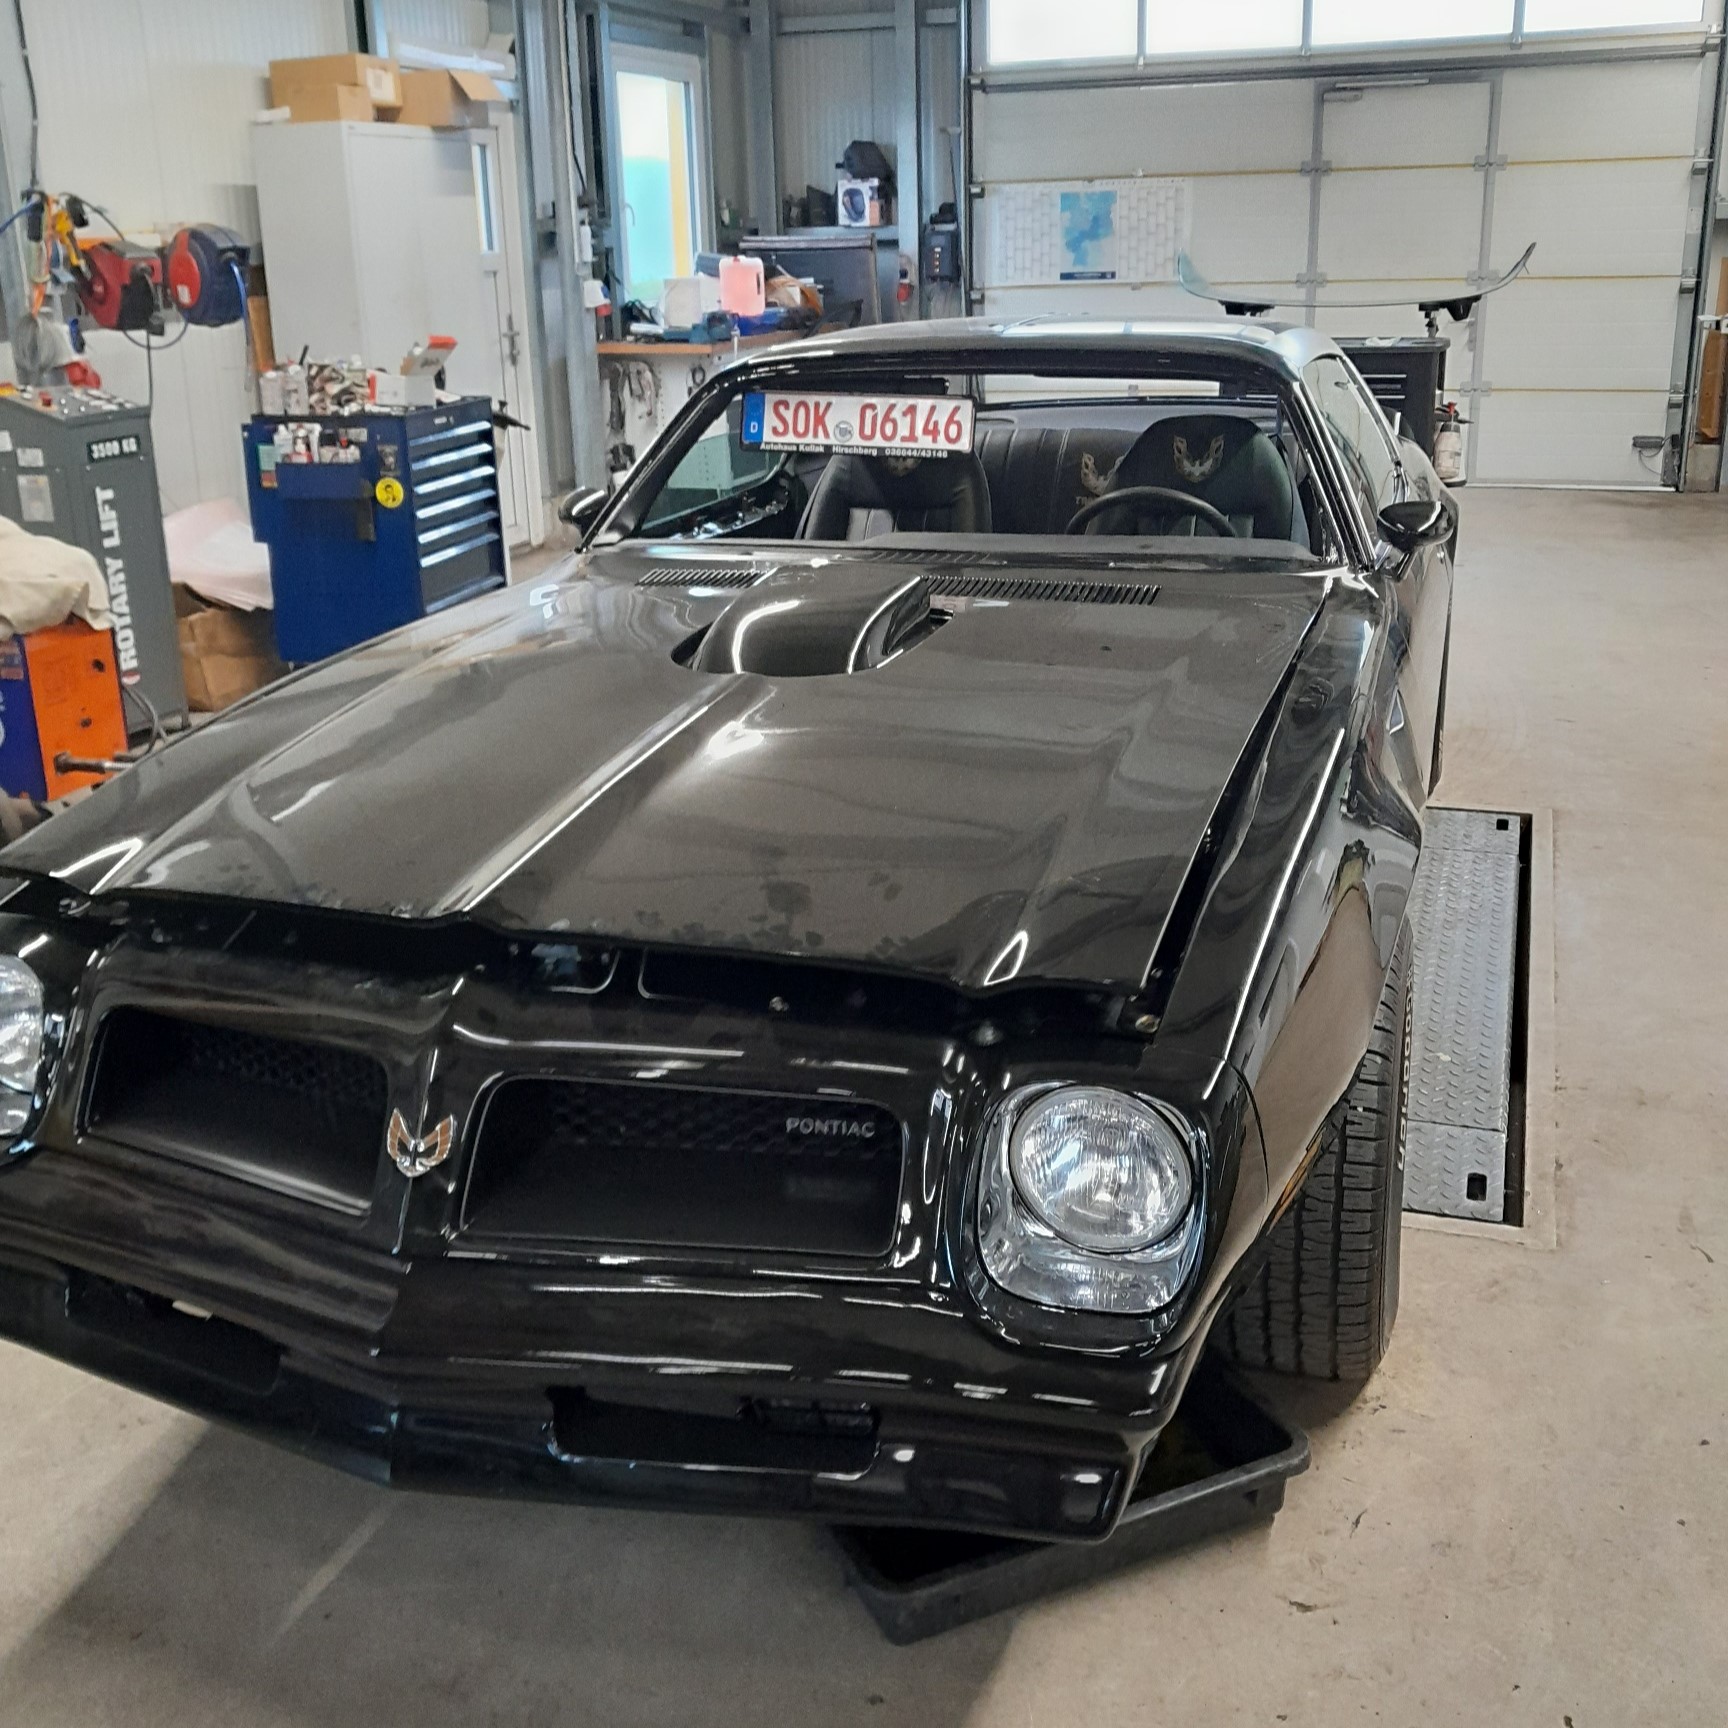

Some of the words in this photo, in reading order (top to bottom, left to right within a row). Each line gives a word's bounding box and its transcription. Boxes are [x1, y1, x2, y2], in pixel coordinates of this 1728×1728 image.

[750, 421, 758, 434] D
[771, 399, 833, 440] SOK
[858, 402, 963, 444] 06146
[760, 442, 797, 451] Autohaus
[832, 445, 878, 457] Hirschberg
[95, 486, 121, 549] LIFT
[105, 557, 139, 672] ROTARY
[785, 1117, 875, 1138] PONTIAC
